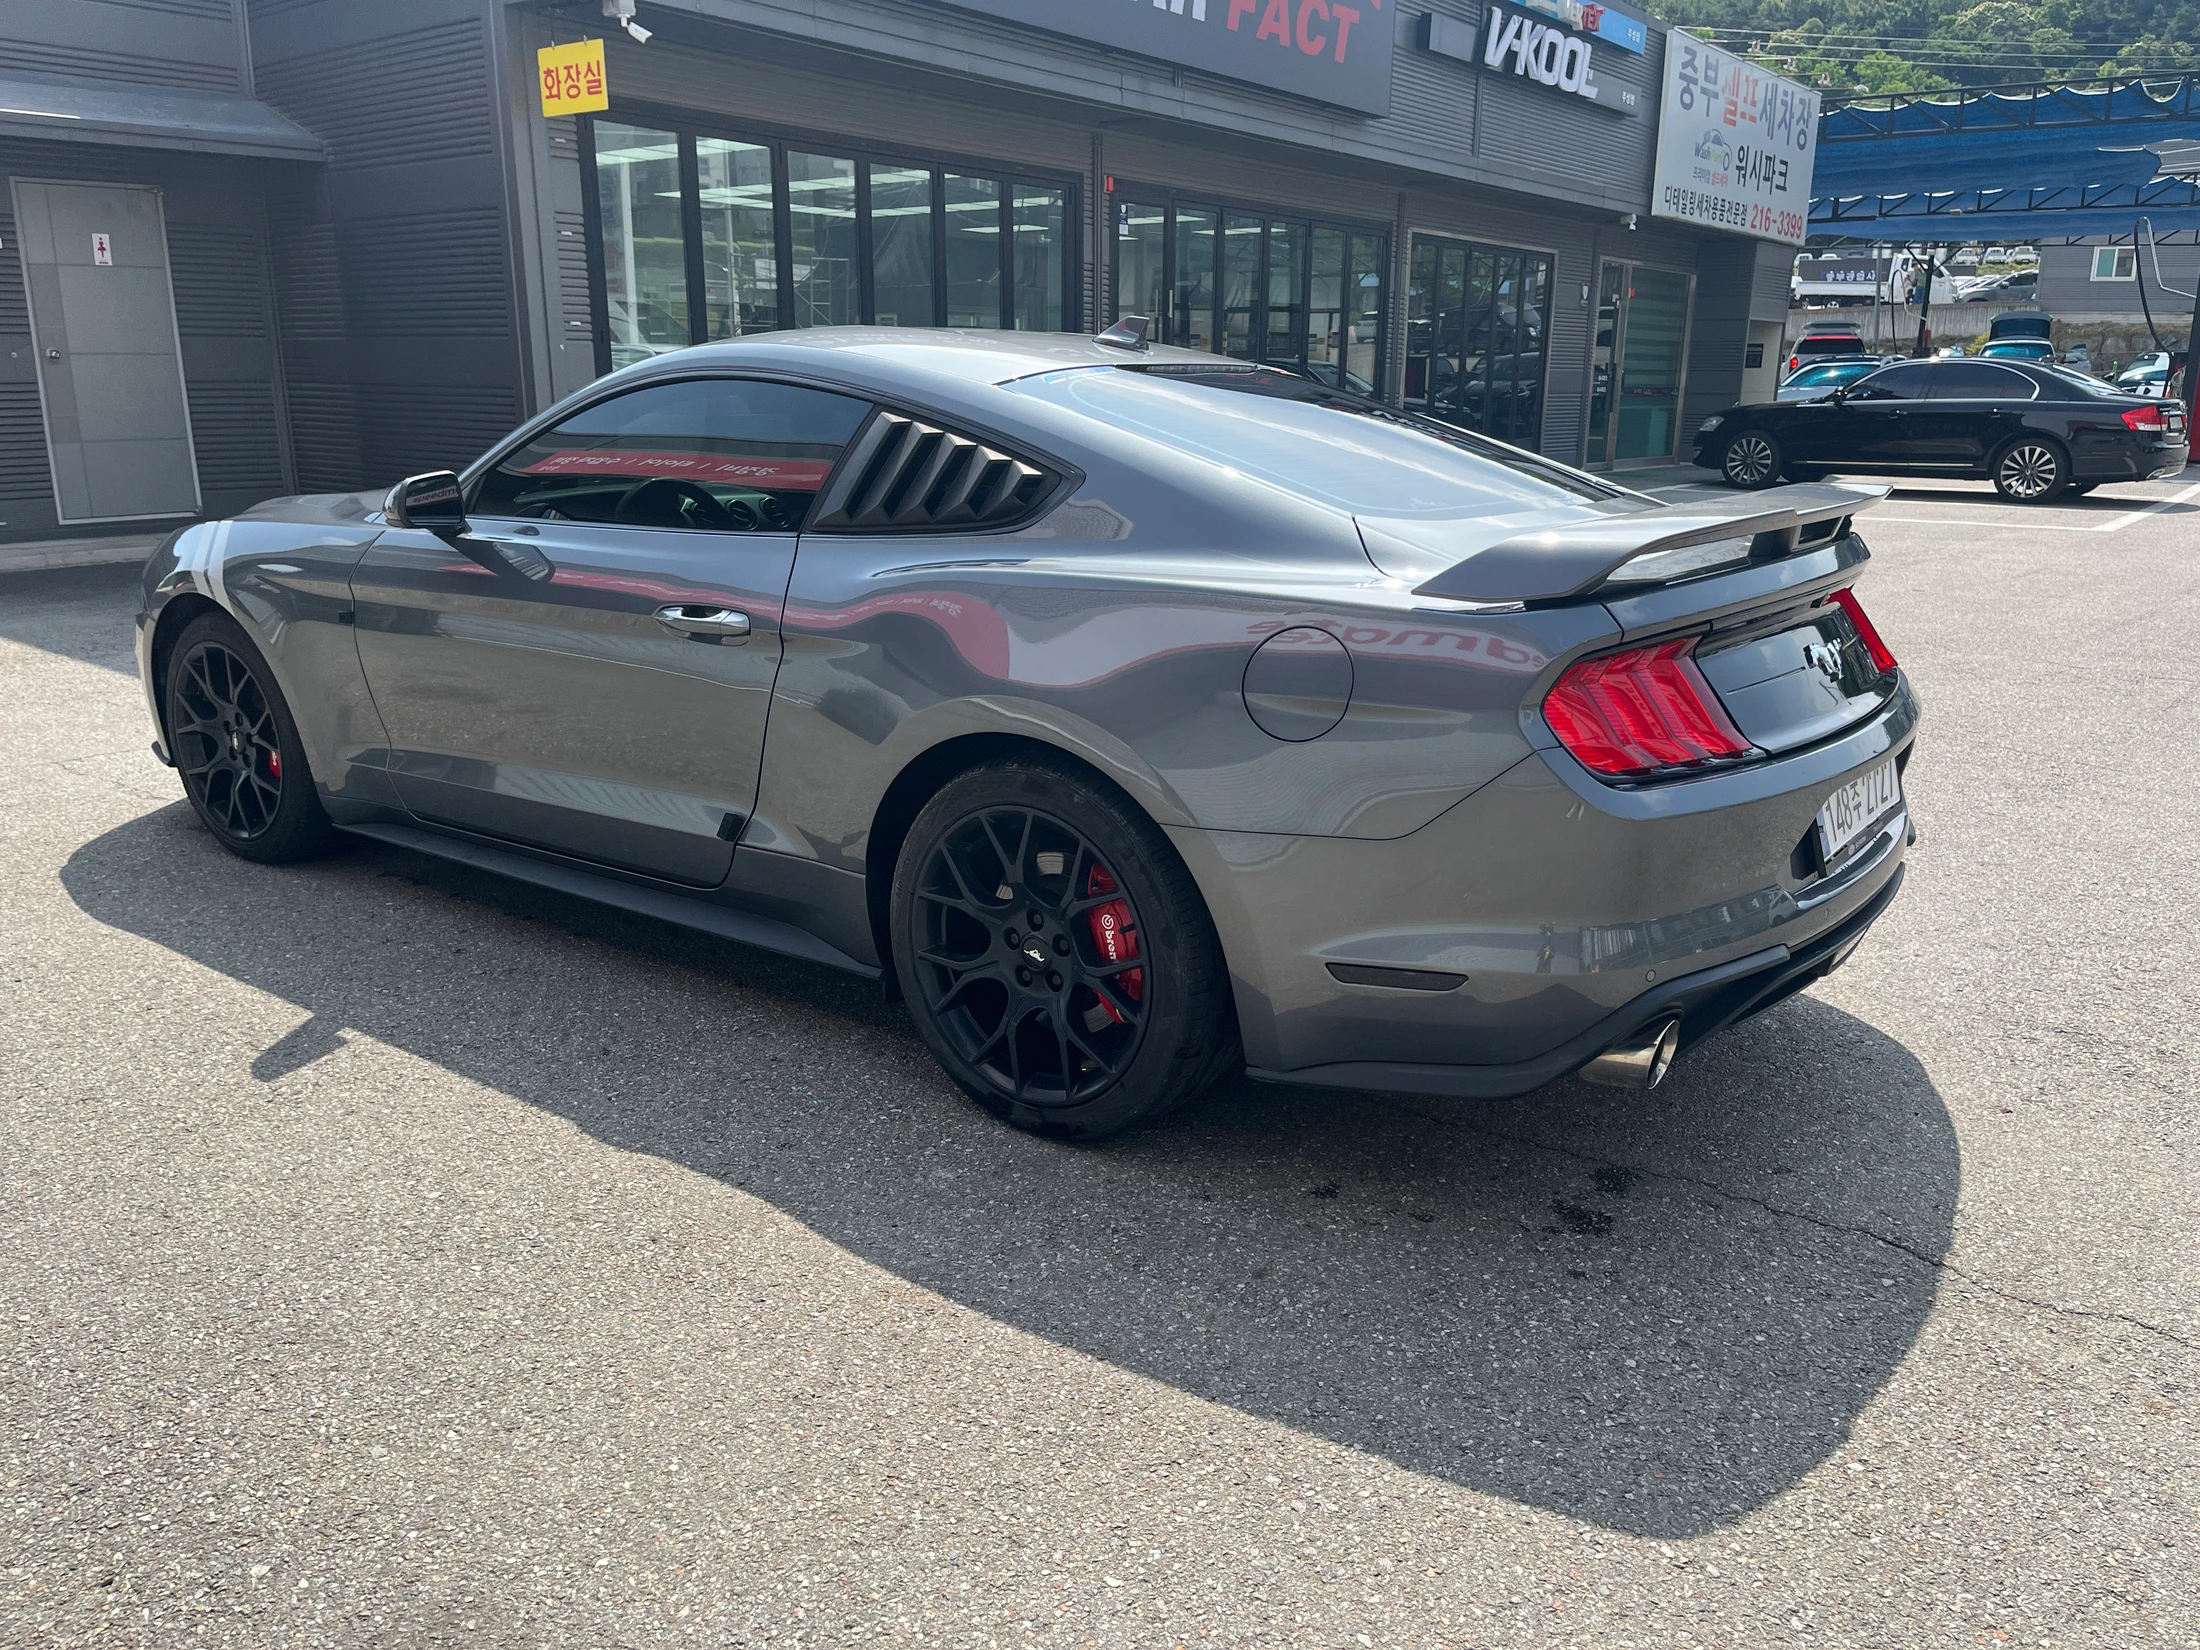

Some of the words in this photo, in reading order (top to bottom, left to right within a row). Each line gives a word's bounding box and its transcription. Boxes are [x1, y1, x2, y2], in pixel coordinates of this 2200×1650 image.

[1226, 0, 1360, 63] FACT
[1484, 6, 1598, 99] V-KOOL
[543, 60, 602, 100] 화장실
[1735, 145, 1789, 195] 워시파크
[1750, 203, 1803, 239] 216-3399
